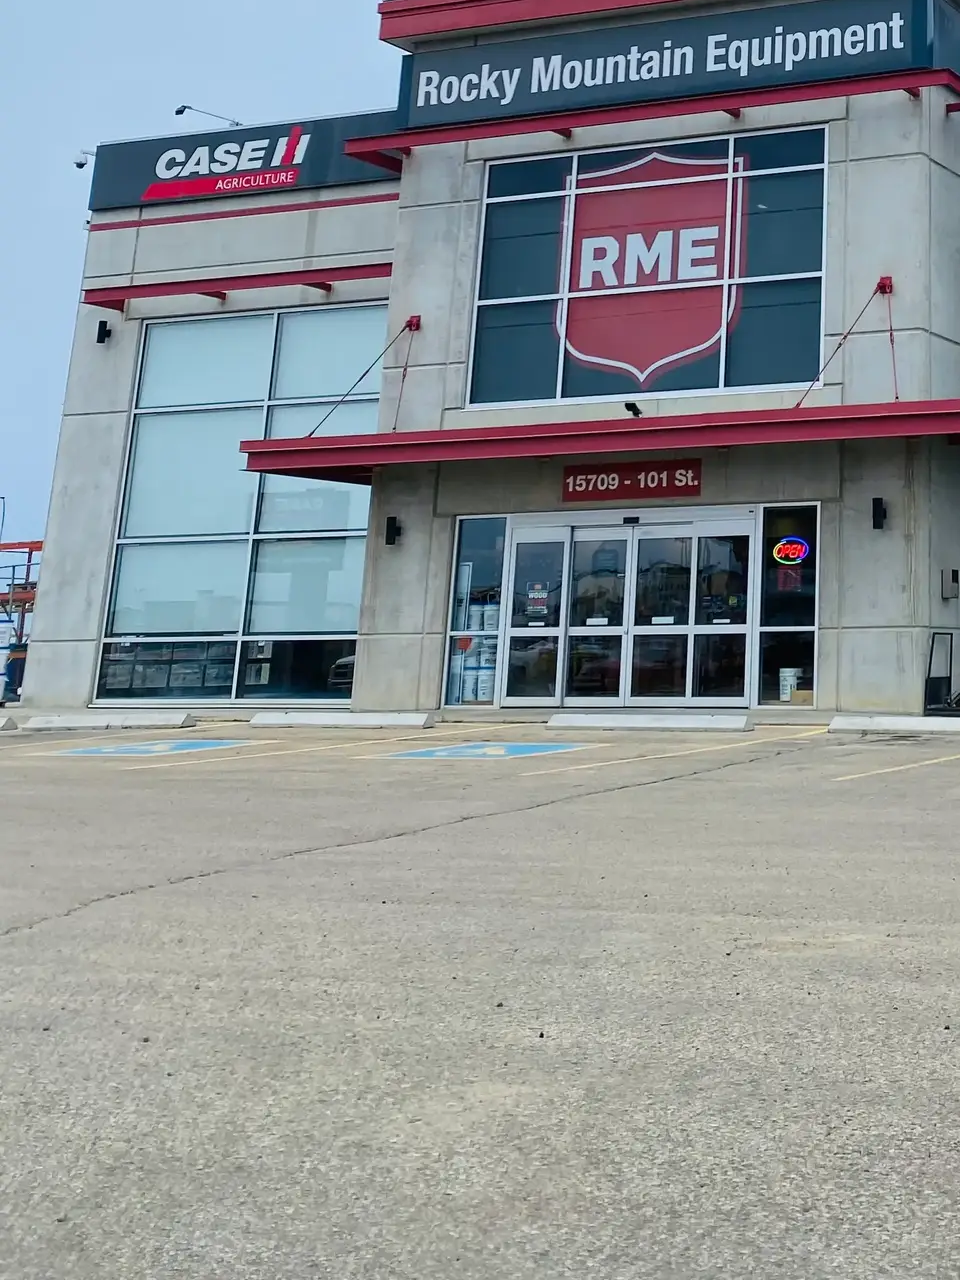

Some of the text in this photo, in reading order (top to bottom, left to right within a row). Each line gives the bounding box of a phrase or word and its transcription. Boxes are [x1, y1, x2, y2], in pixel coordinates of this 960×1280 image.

[416, 11, 905, 106] Rocky Mountain Equipment
[155, 138, 270, 180] CASE
[215, 171, 294, 191] AGRICULTURE
[578, 225, 719, 289] RME
[566, 473, 619, 492] 15709
[637, 470, 668, 489] 101
[674, 468, 699, 487] St.
[776, 543, 807, 559] OPEN
